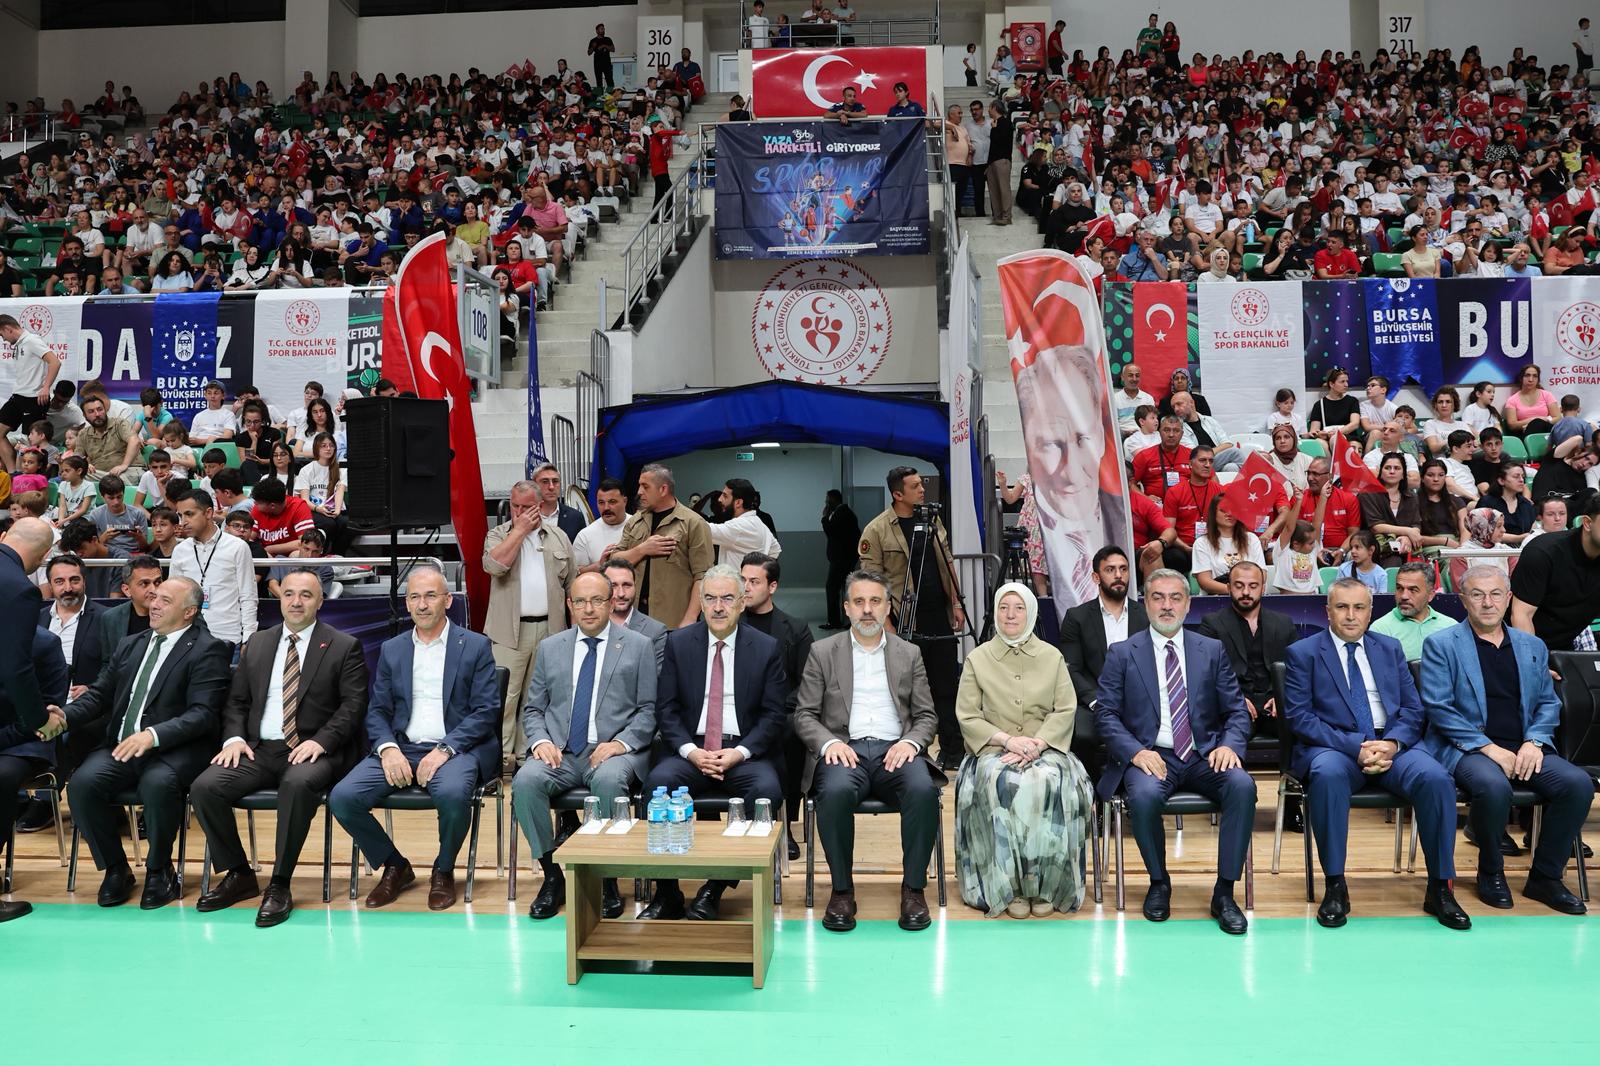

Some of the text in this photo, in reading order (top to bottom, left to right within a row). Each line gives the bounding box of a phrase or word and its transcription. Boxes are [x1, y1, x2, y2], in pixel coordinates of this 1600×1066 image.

[1390, 16, 1412, 32] 317
[648, 30, 672, 46] 316
[1390, 39, 1414, 56] 211
[647, 52, 671, 68] 210
[763, 136, 792, 145] YAZA
[847, 294, 858, 305] VE
[854, 304, 866, 329] SPOR
[1373, 308, 1432, 322] BURSA
[472, 308, 488, 342] 108
[1374, 320, 1433, 333] BÜYÜKŞEHİR
[1234, 329, 1274, 340] GENÇLİK
[1375, 332, 1434, 344] BELEDİYESİ
[286, 338, 323, 348] GENÇLİK
[326, 338, 336, 346] VE
[1214, 339, 1289, 349] SPOR BAKANLIĞI
[268, 346, 337, 357] SPOR BAKANLIĞI
[1552, 364, 1600, 376] T.C. GENÇLİ
[156, 376, 208, 389] BURSA
[1549, 376, 1576, 386] SPOR
[160, 388, 206, 400] ÜYÜKŞEHİ
